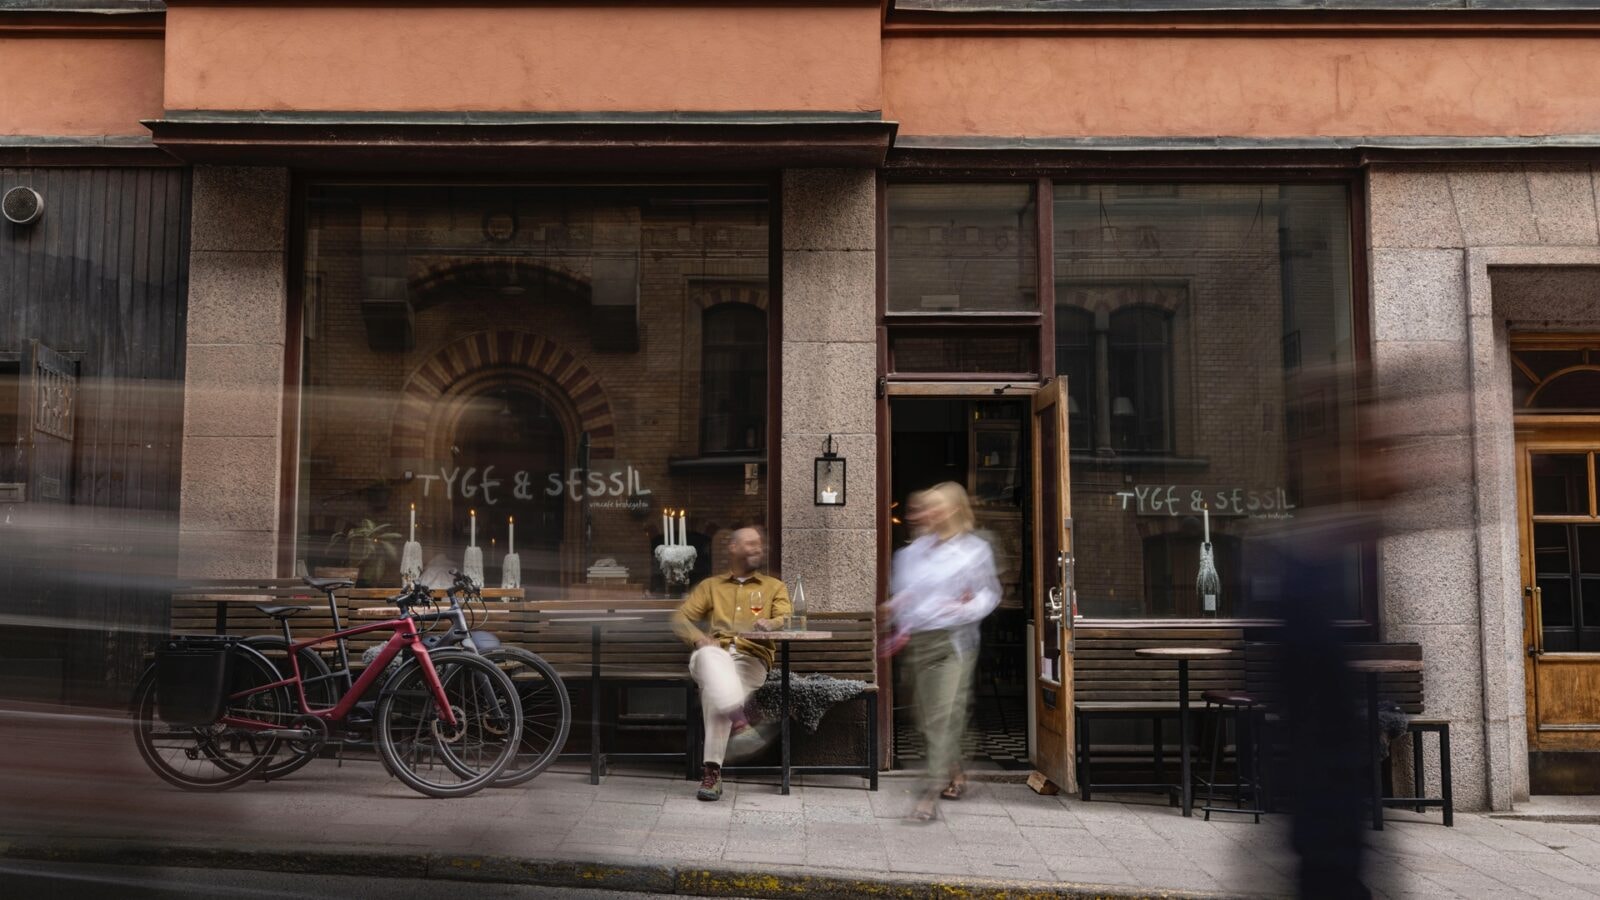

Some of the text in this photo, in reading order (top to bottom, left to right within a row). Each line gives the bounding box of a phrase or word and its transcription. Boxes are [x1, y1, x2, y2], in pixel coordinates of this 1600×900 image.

[416, 465, 652, 505] TYGE & SESSIL
[1116, 485, 1295, 516] TYGE & SESSIL
